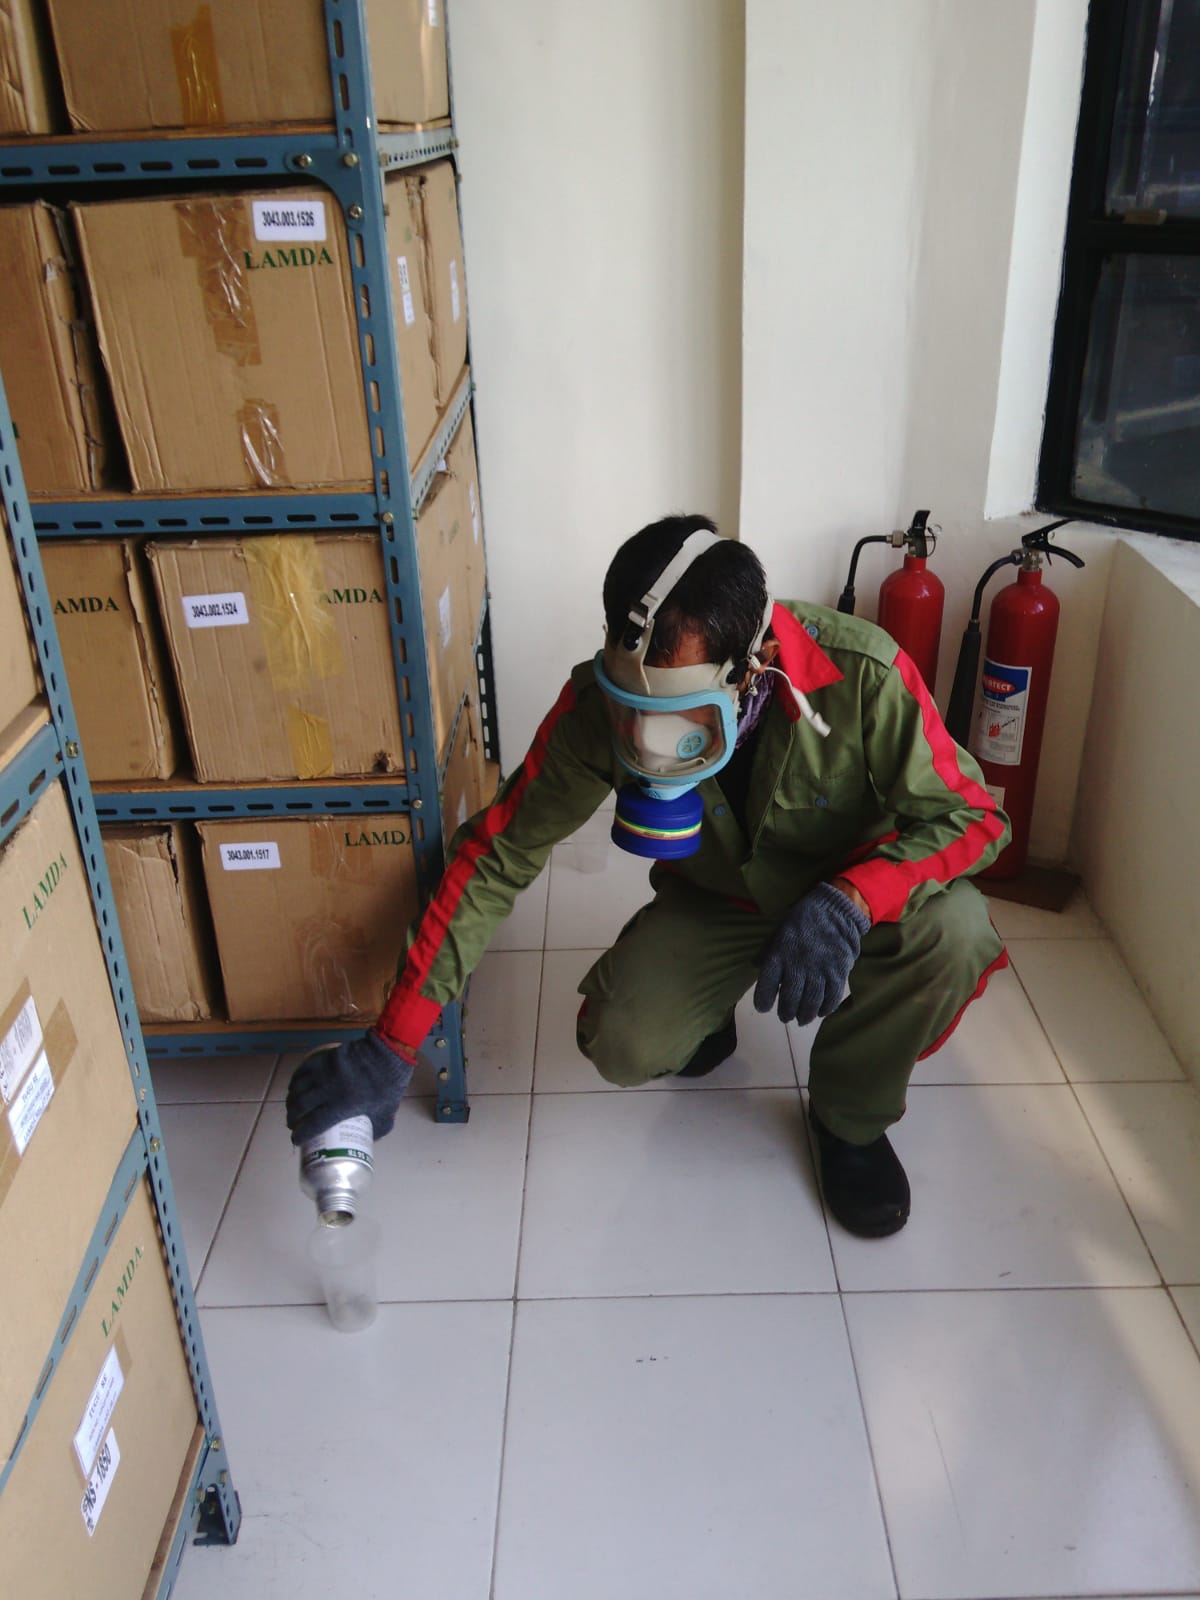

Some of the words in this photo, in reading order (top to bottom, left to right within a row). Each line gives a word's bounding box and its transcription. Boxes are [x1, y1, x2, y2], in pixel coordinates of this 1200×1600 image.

[261, 210, 315, 227] 3043.003.1526
[243, 247, 334, 270] LAMDA
[53, 596, 120, 615] AMDA
[318, 587, 383, 605] AMDA
[22, 851, 68, 931] LAMDA
[101, 1246, 143, 1338] LAMDA
